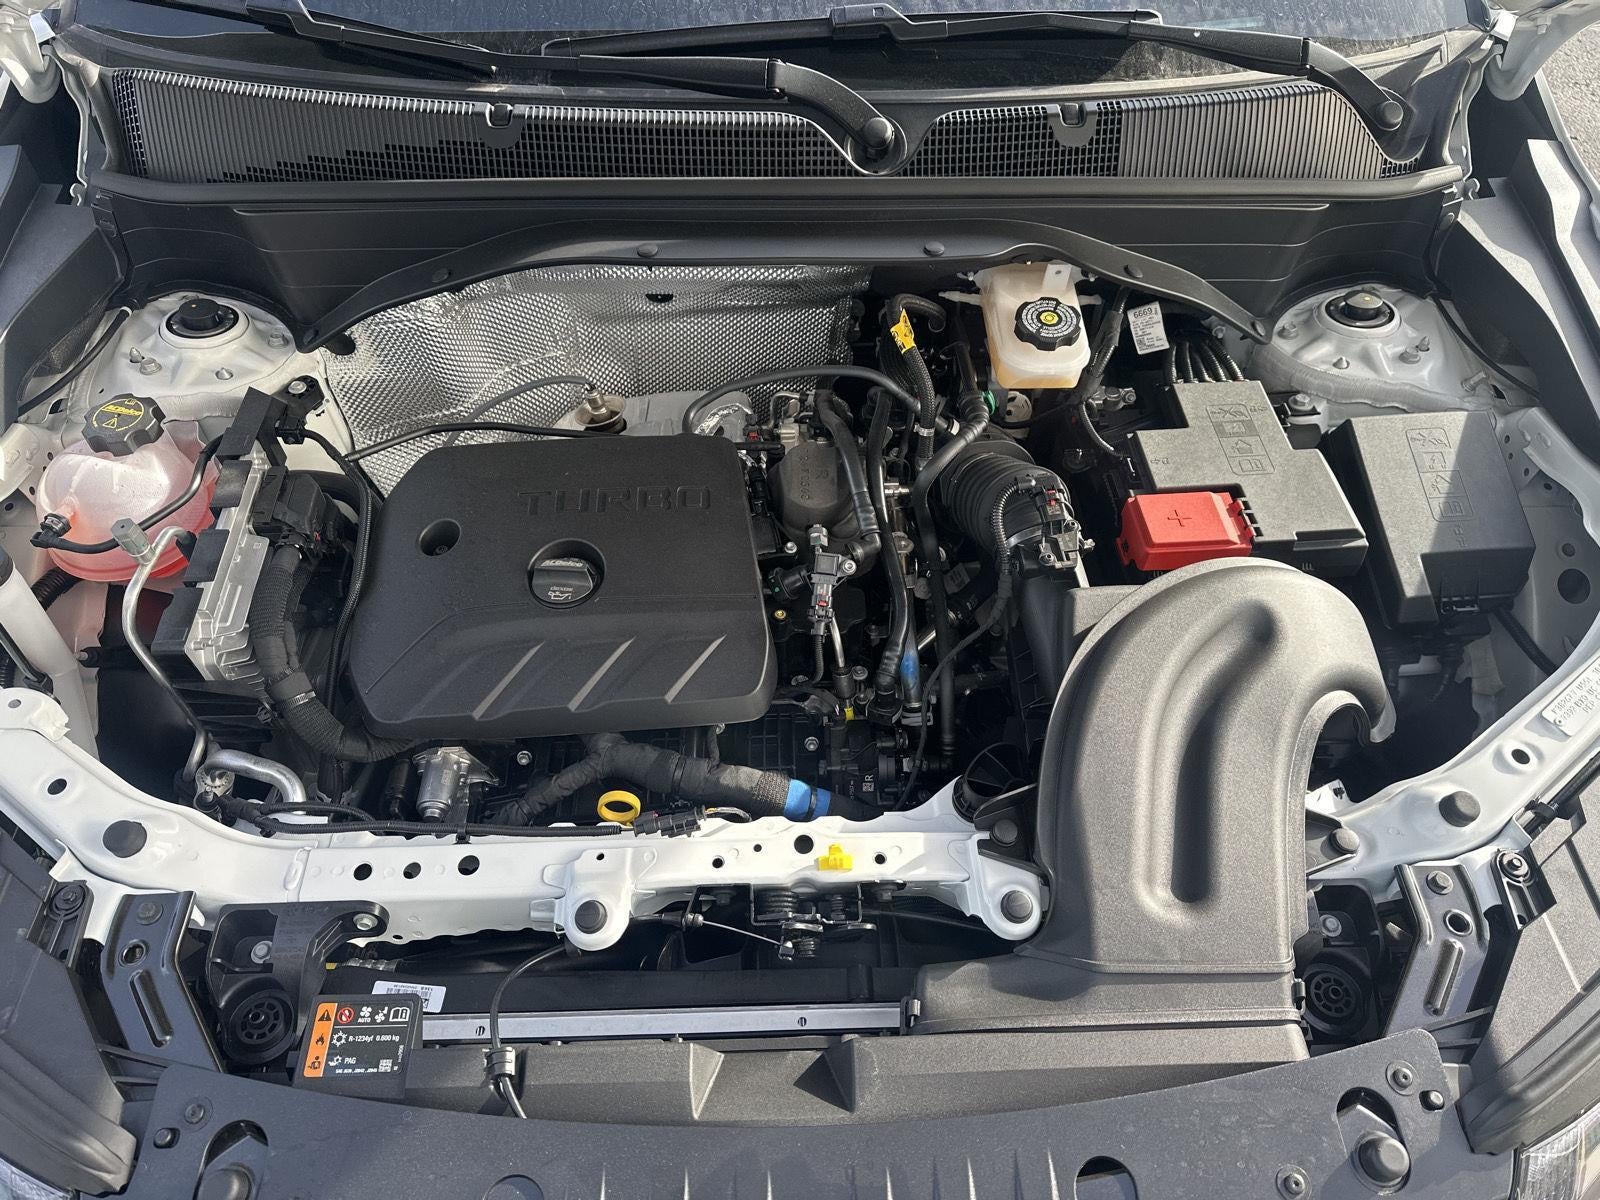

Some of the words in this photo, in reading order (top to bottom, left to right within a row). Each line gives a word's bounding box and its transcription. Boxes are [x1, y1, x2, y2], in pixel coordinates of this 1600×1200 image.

[1133, 307, 1153, 319] 6669
[518, 486, 711, 515] TURBO
[541, 559, 584, 568] ACDelco
